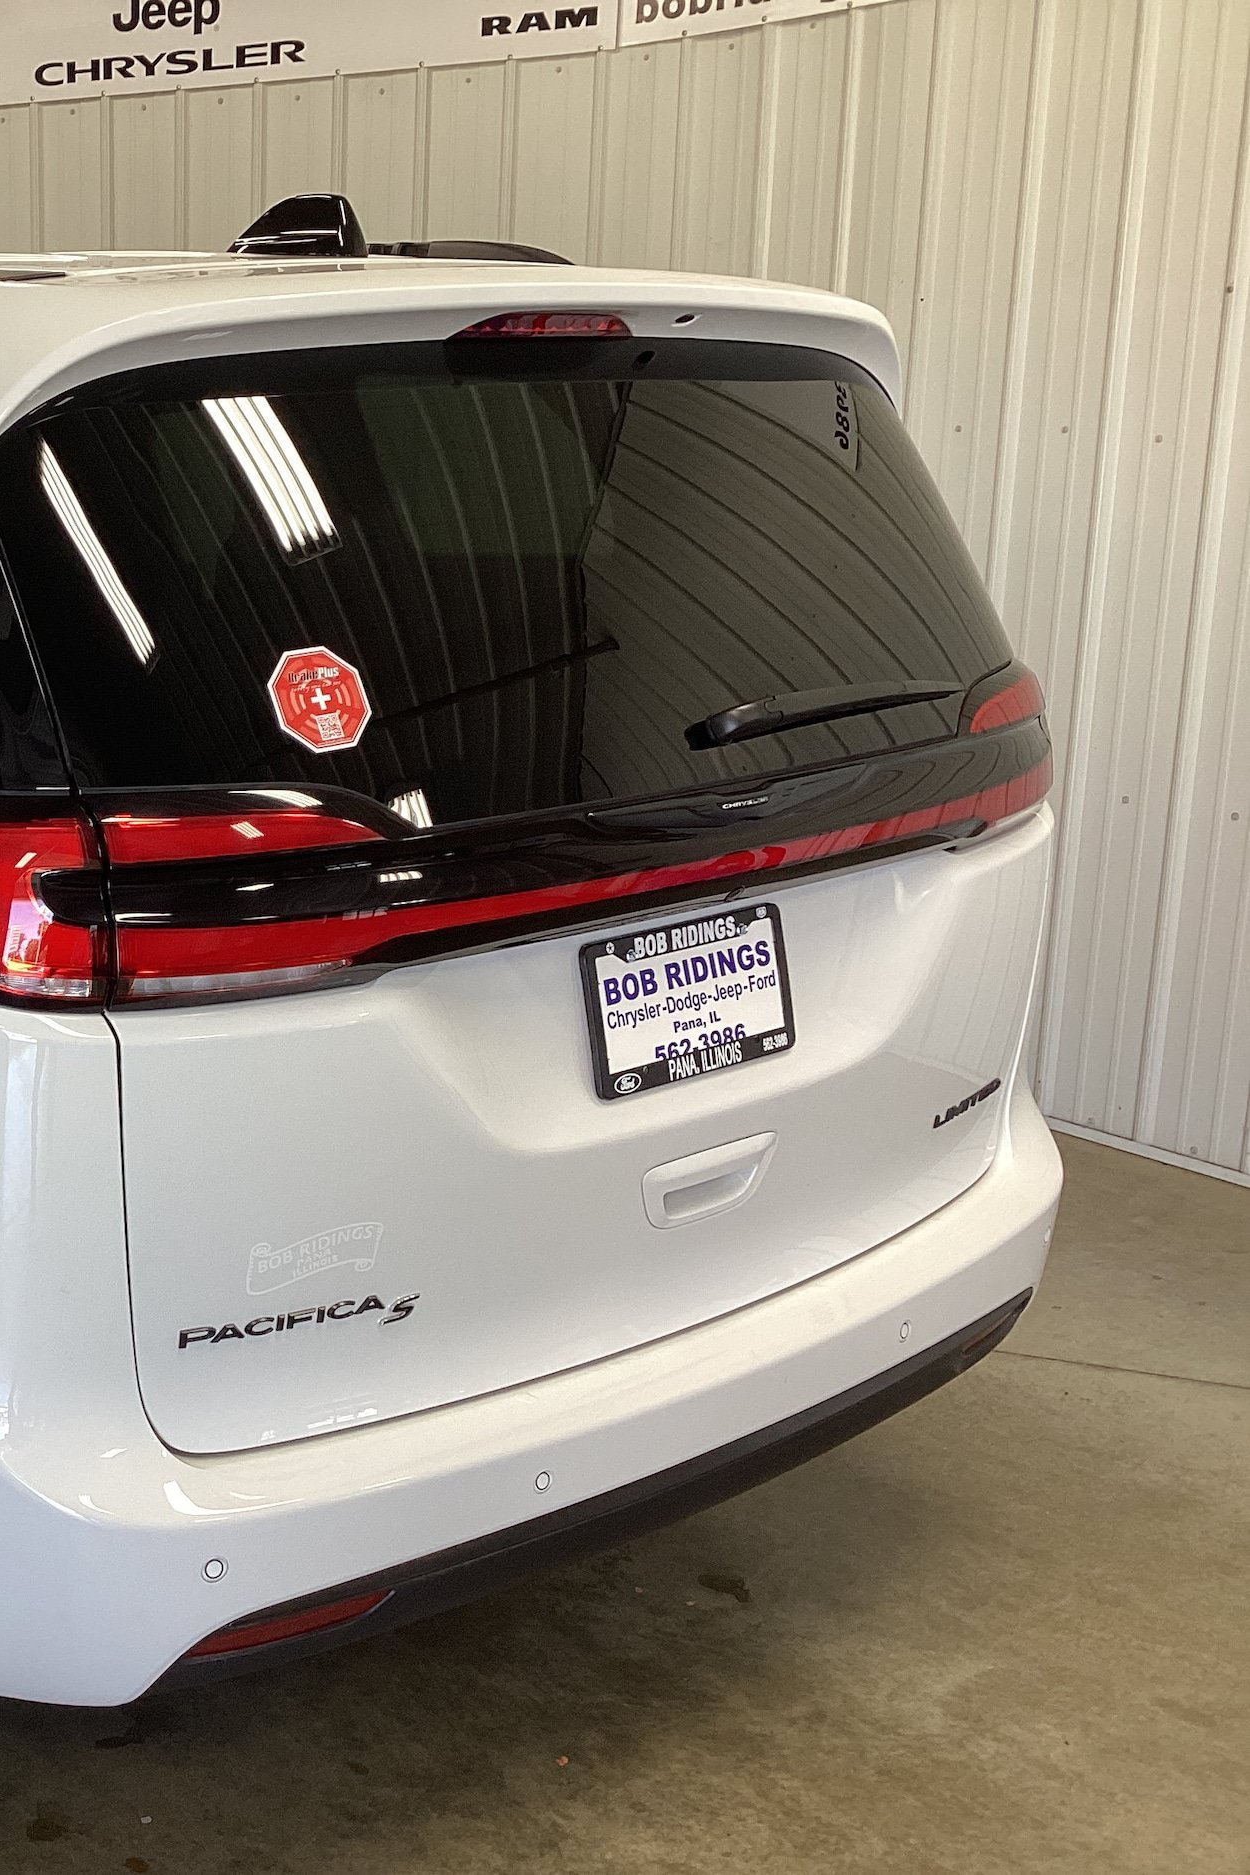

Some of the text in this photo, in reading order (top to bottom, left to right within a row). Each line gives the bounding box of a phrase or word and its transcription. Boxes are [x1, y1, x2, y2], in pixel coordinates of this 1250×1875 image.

[113, 0, 220, 35] Jeep
[481, 5, 598, 37] RAM
[34, 40, 306, 87] CHRYSLER
[634, 916, 736, 959] BOB RIDINGS
[603, 940, 771, 1006] BOB RIDINGS
[607, 970, 776, 1029] Chrysler-Dodge-Jeep-Ford
[673, 1010, 721, 1033] Pana, IL
[700, 1041, 742, 1072] ILLINOIS
[258, 1225, 374, 1273] BOB RIDINGS
[293, 1254, 339, 1277] ILLINOIS
[296, 1248, 331, 1264] PANA
[178, 1292, 421, 1349] PACIFICA S
